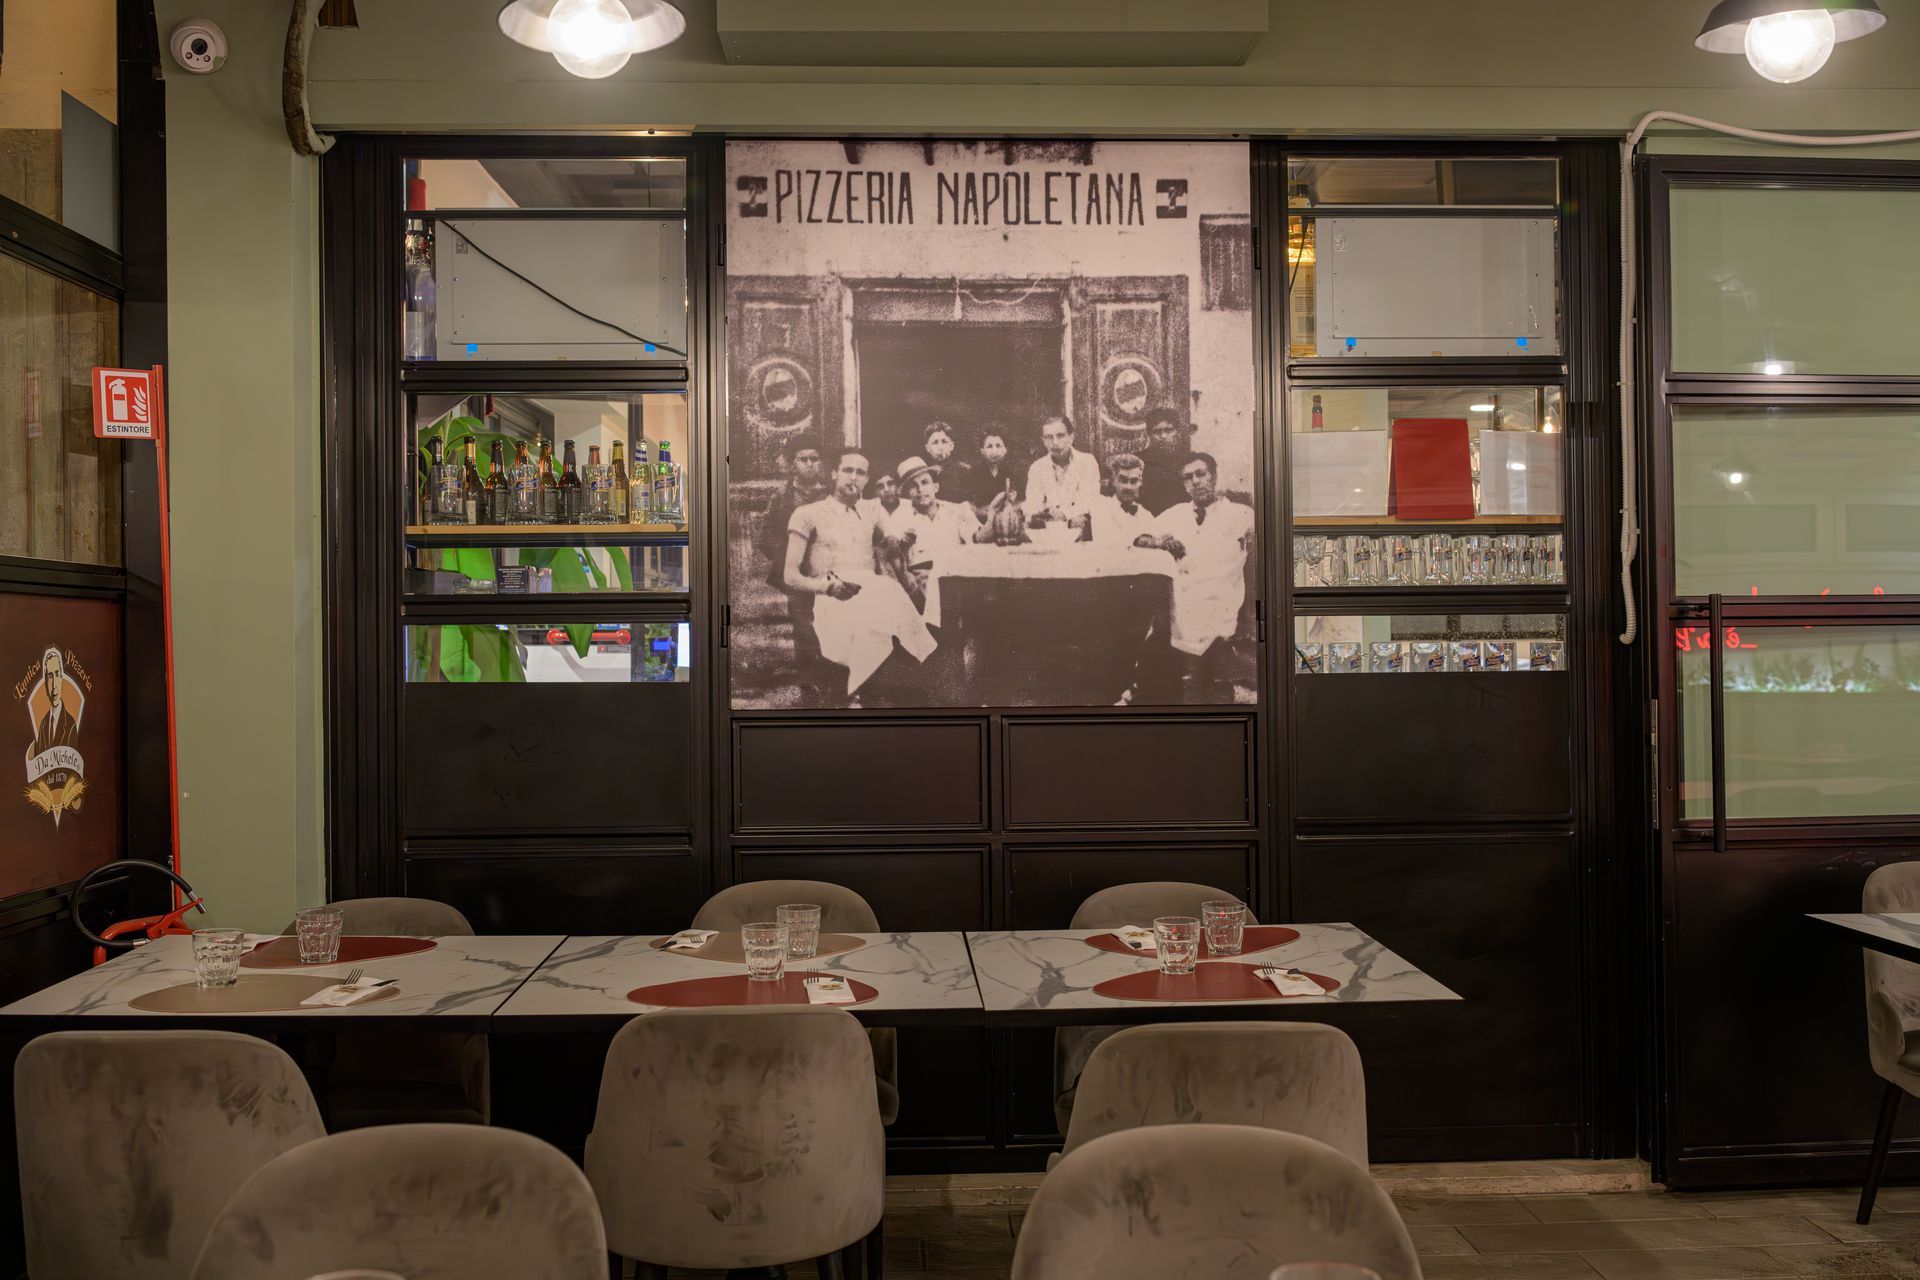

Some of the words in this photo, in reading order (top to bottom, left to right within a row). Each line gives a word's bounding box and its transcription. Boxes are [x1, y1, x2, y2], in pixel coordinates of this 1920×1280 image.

[774, 169, 914, 224] PIZZERIA
[937, 171, 1144, 226] NAPOLETANA
[106, 425, 149, 433] ESTINTORE
[65, 649, 92, 692] Pizzeria
[35, 756, 49, 774] Da
[50, 750, 78, 768] Michele
